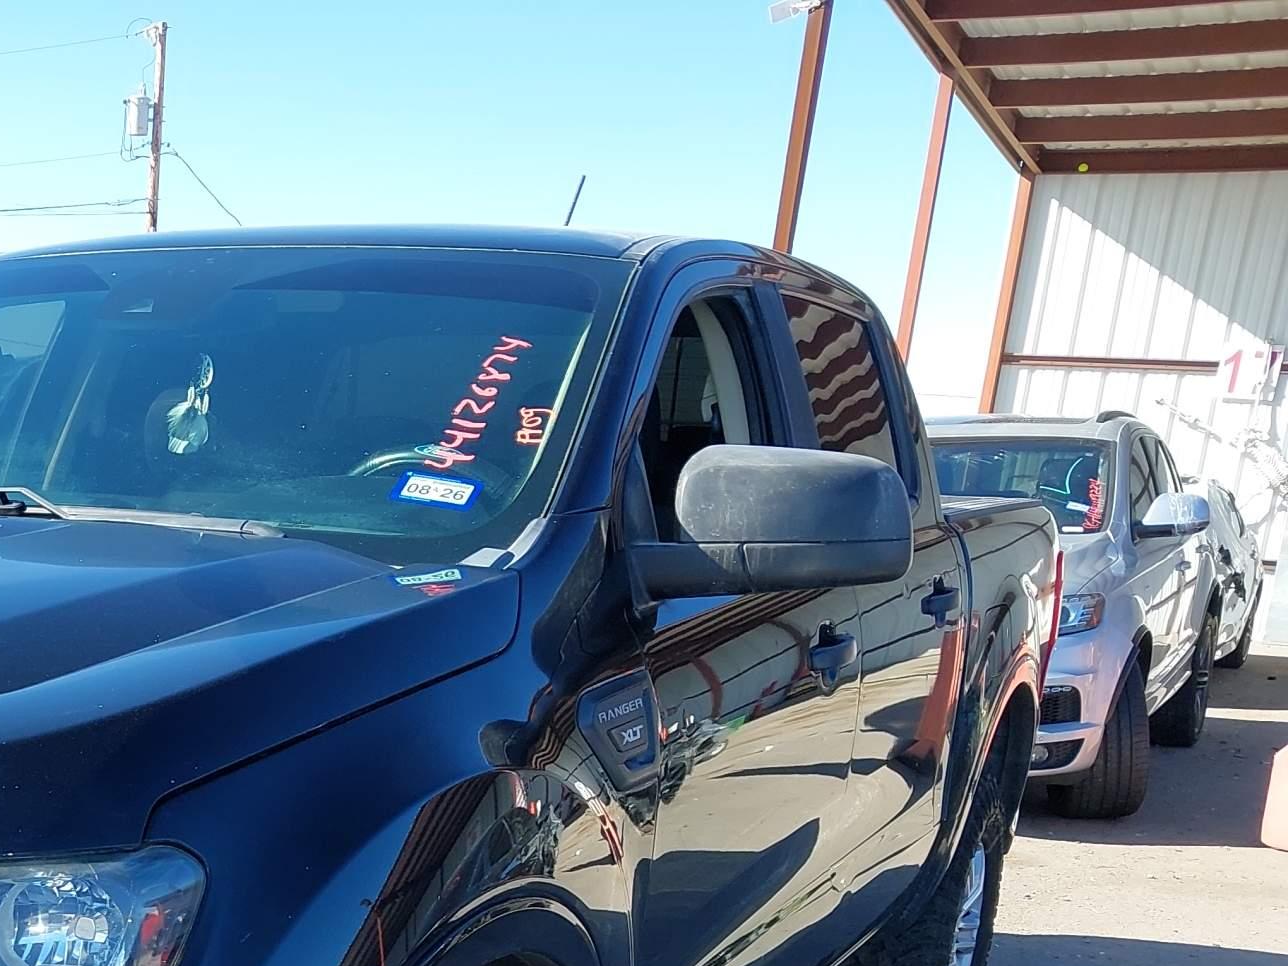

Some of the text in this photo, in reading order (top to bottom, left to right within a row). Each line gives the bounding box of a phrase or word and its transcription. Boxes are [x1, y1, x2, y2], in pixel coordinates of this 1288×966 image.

[423, 335, 533, 469] 44126874
[406, 483, 432, 495] 08
[439, 488, 466, 501] 26
[598, 698, 644, 725] RANGER
[619, 724, 644, 745] XLT
